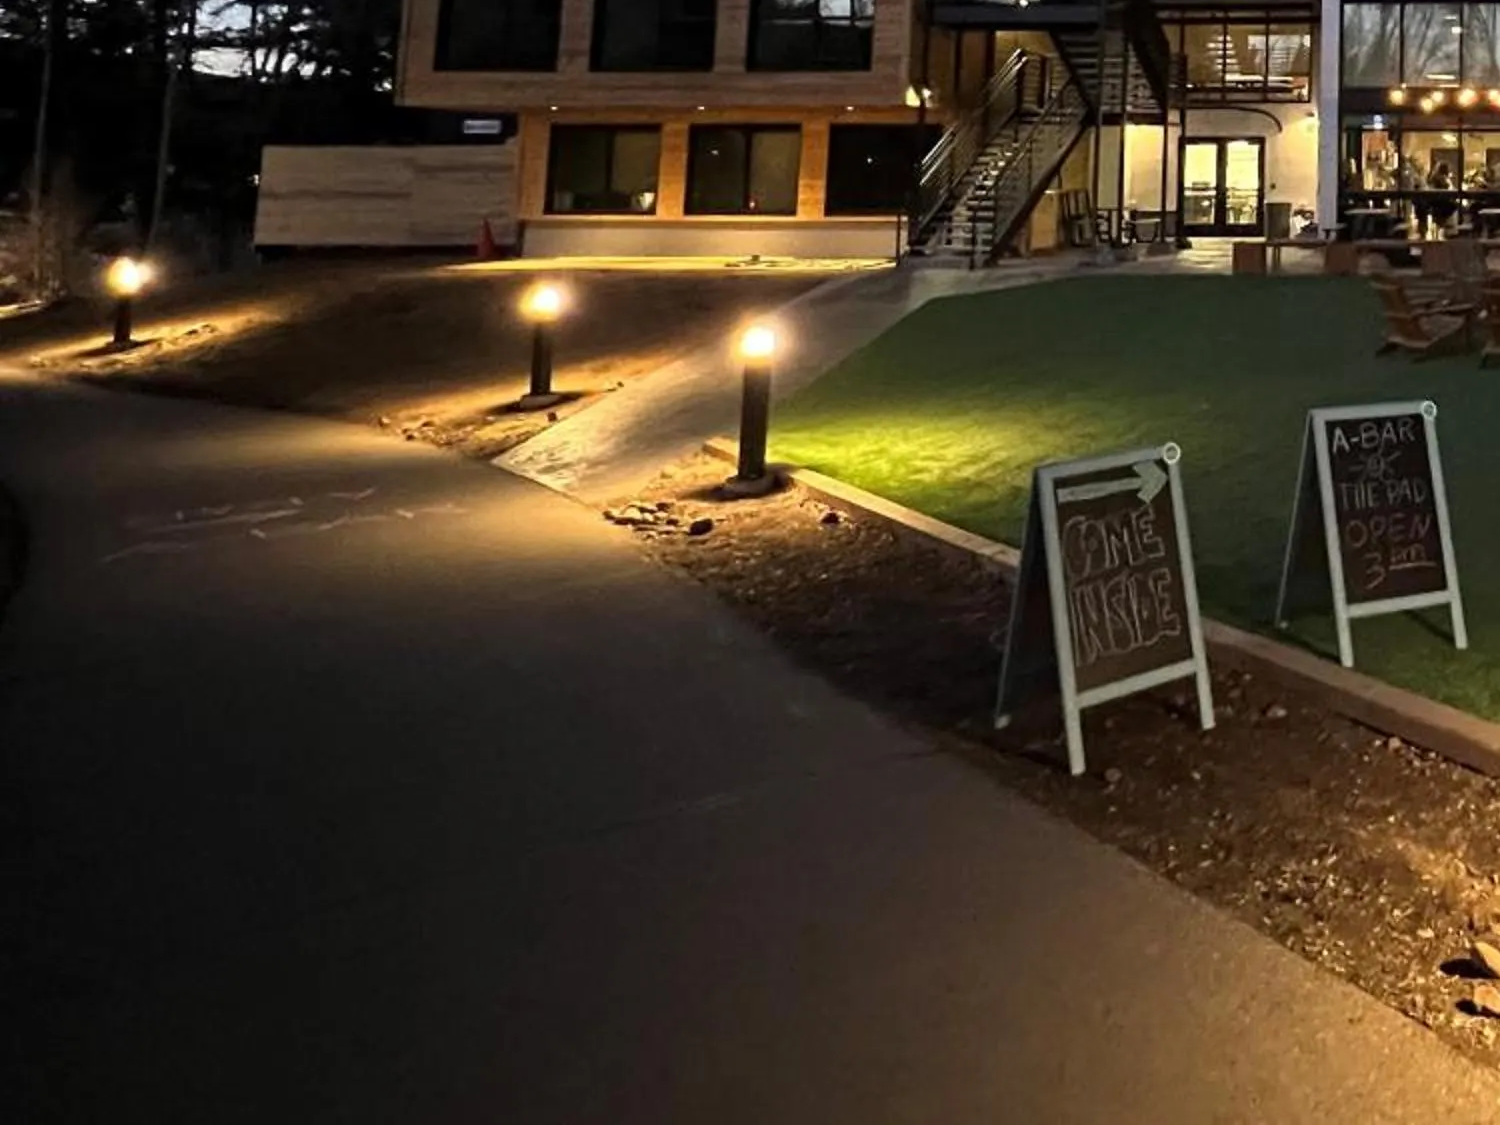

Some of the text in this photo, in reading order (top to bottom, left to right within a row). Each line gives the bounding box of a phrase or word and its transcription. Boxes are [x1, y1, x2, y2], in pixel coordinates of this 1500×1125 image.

[1333, 416, 1416, 454] A-BAR
[1339, 476, 1427, 511] THE PAD
[1063, 504, 1164, 579] COME
[1345, 512, 1432, 548] OPEN
[1069, 568, 1180, 667] INSIDE
